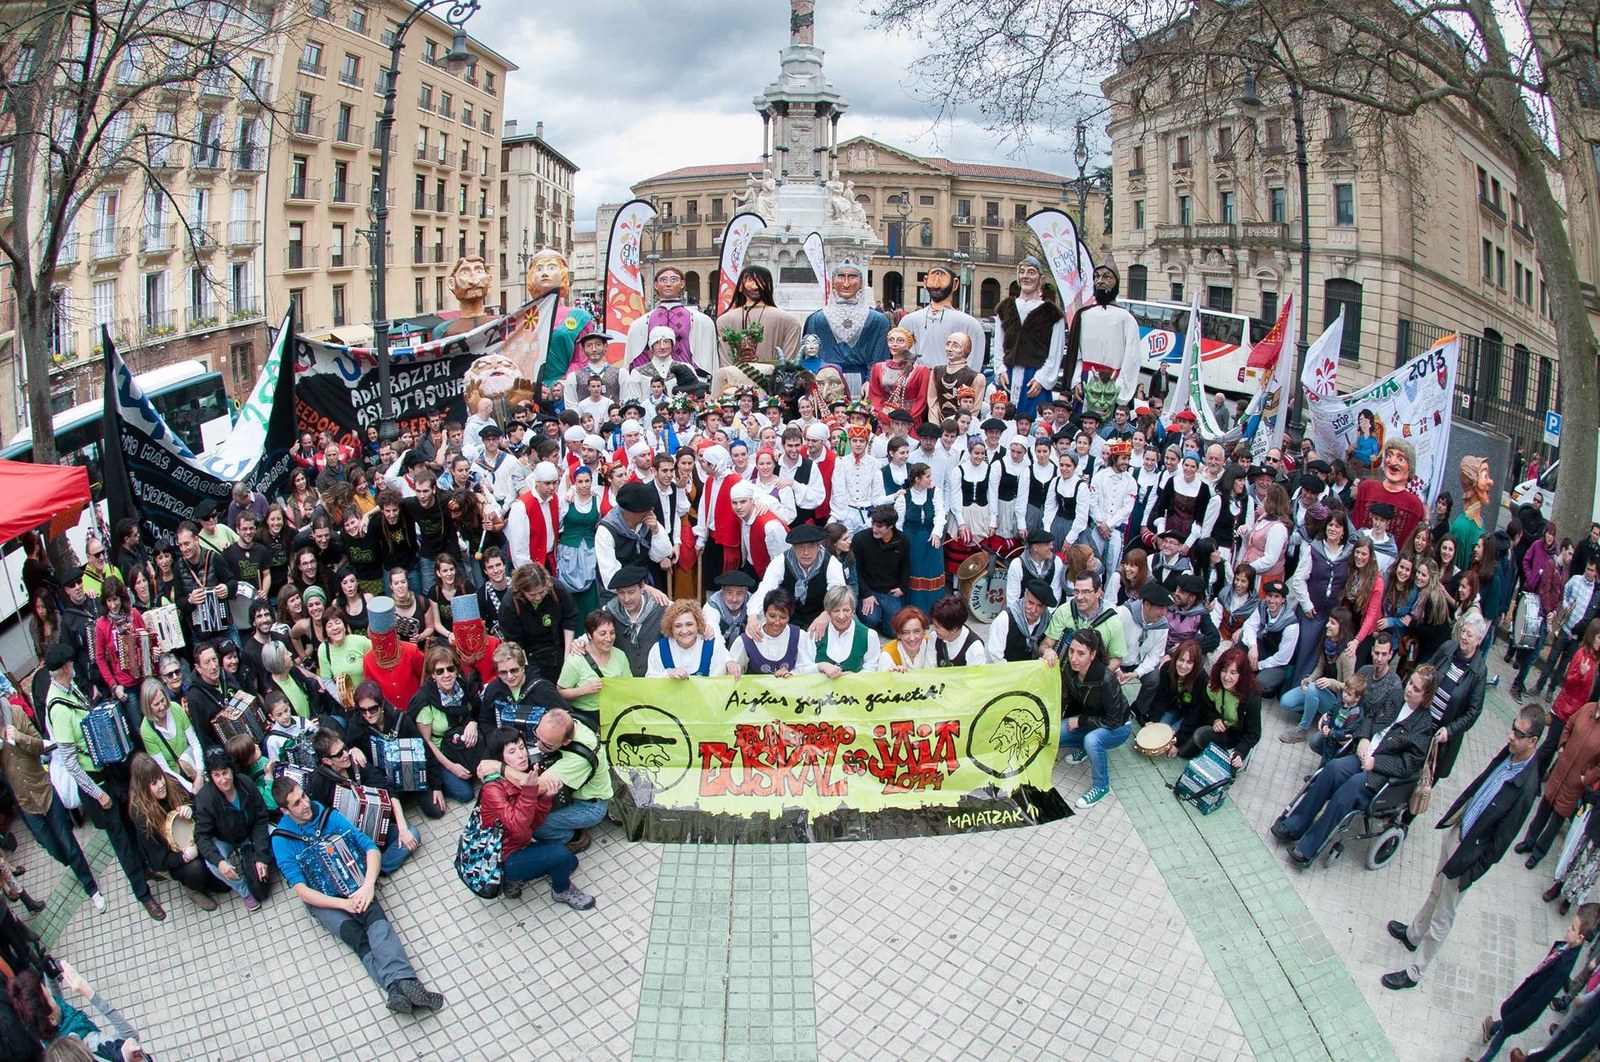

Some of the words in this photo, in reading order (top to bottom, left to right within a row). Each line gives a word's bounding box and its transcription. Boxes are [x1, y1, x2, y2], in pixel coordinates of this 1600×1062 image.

[1406, 347, 1446, 382] 2013
[1331, 413, 1350, 430] STOP
[1548, 415, 1558, 431] P
[140, 443, 171, 470] MÁS
[171, 466, 233, 497] ATAQUES
[142, 483, 200, 522] KONTRA
[947, 807, 1024, 829] MAIATZAK
